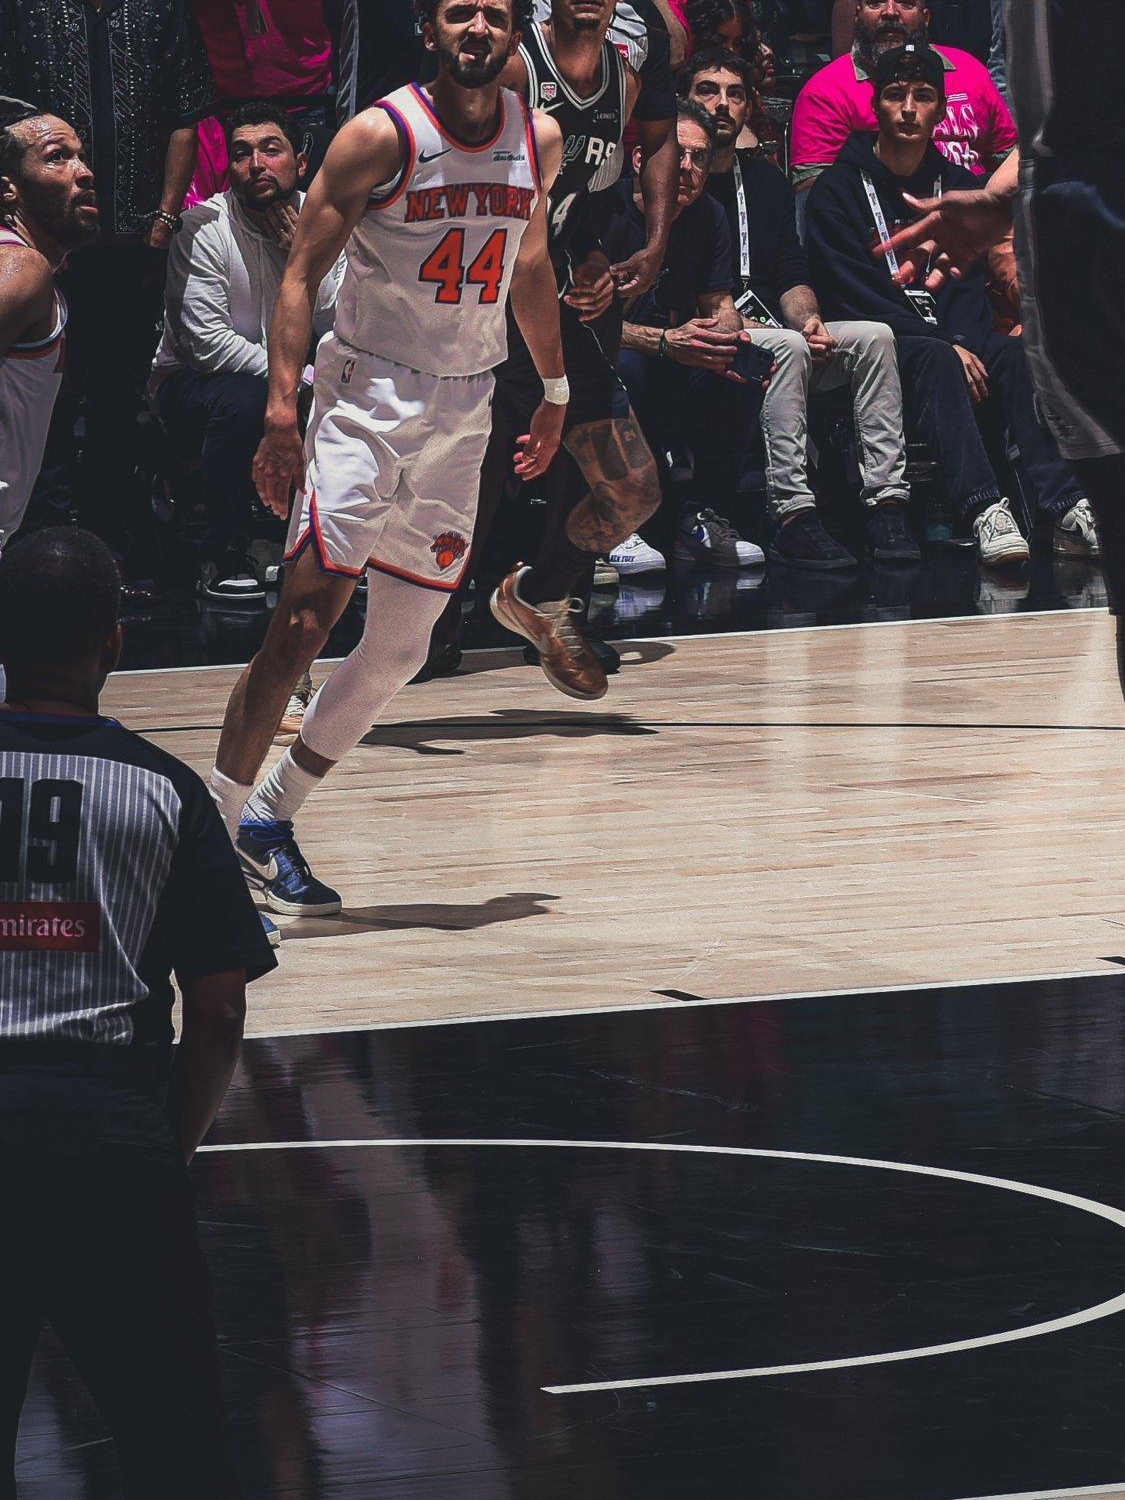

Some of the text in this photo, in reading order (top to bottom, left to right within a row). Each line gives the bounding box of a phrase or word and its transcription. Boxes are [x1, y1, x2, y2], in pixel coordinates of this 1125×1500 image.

[404, 183, 536, 224] NEW YORK
[418, 228, 509, 303] 44
[0, 912, 86, 938] mirates
